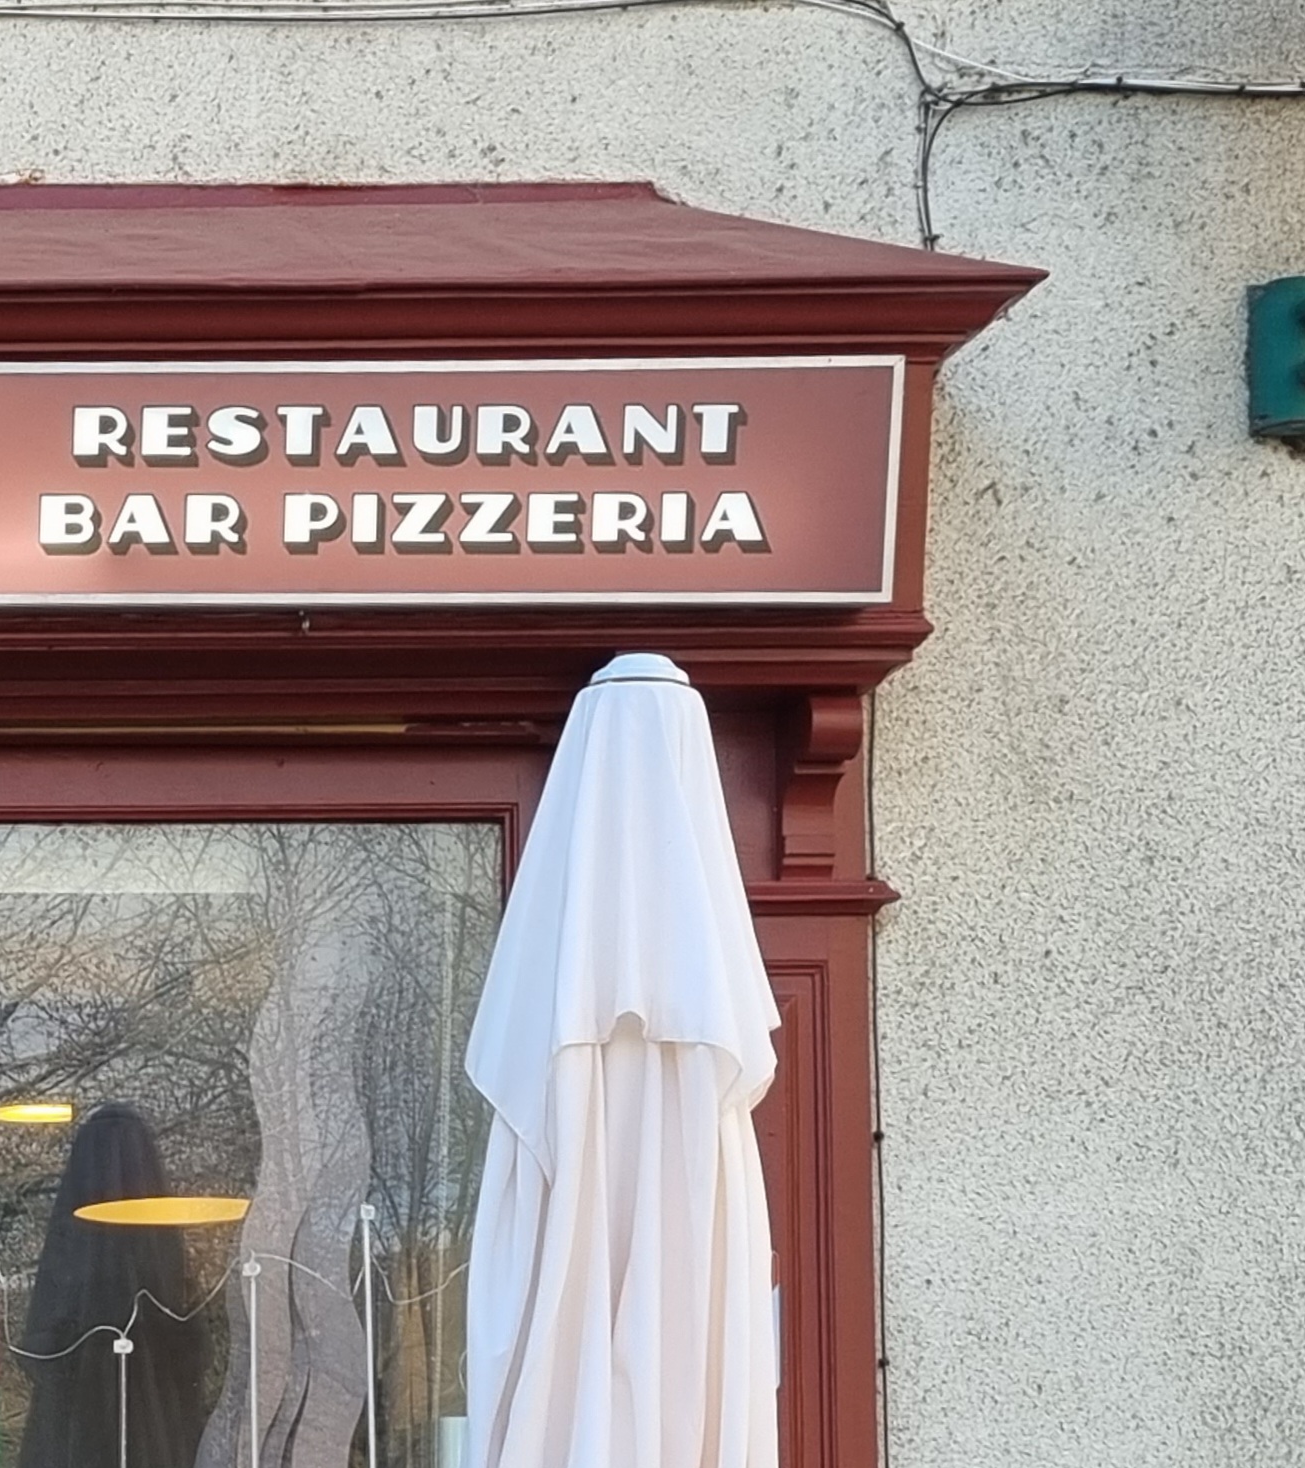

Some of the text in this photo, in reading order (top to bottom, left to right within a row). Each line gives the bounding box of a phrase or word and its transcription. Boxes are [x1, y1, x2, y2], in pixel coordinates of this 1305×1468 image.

[71, 402, 747, 465] RESTAURANT
[38, 490, 771, 554] BAR PIZZERIA
